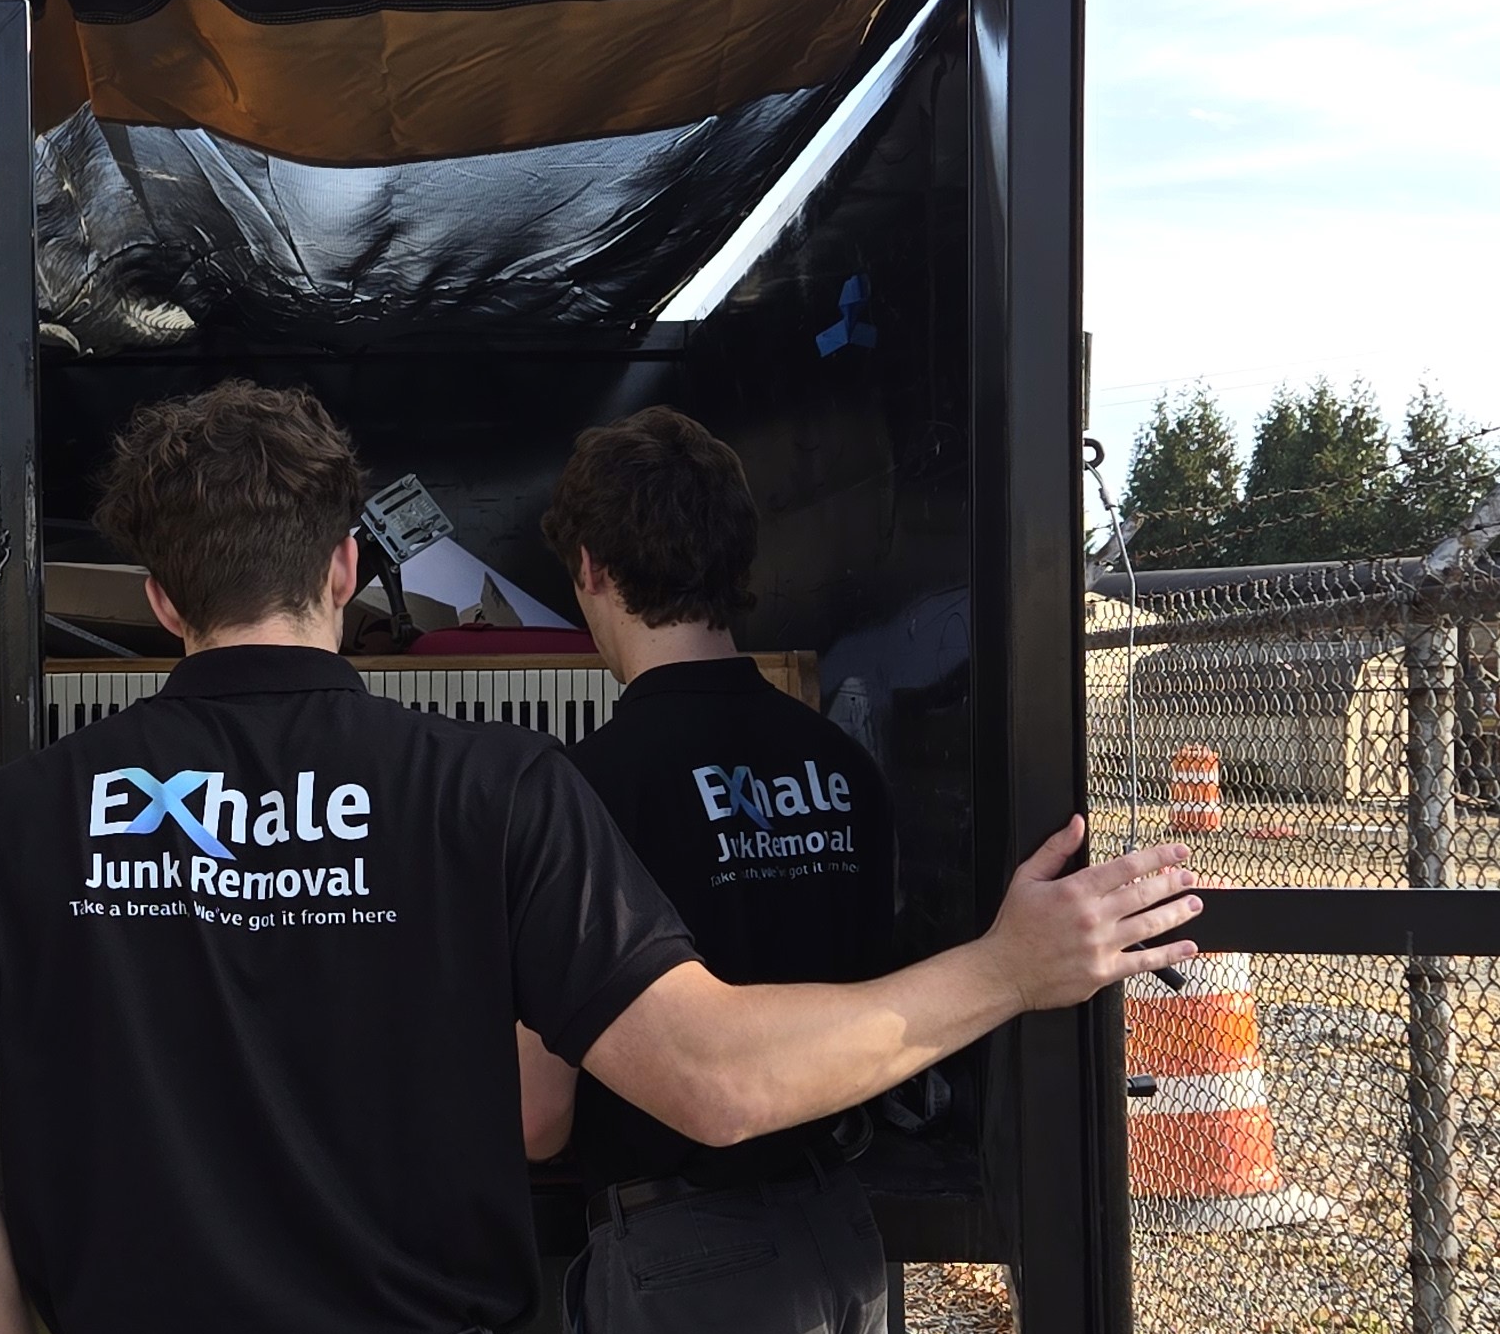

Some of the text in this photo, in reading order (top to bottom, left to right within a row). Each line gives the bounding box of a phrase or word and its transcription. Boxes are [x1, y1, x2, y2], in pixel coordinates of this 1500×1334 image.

[756, 826, 854, 858] Remoal
[85, 851, 370, 900] Junk Removal
[109, 904, 122, 917] a
[249, 913, 275, 931] got
[282, 910, 296, 925] it
[301, 909, 346, 925] from
[352, 908, 397, 923] here
